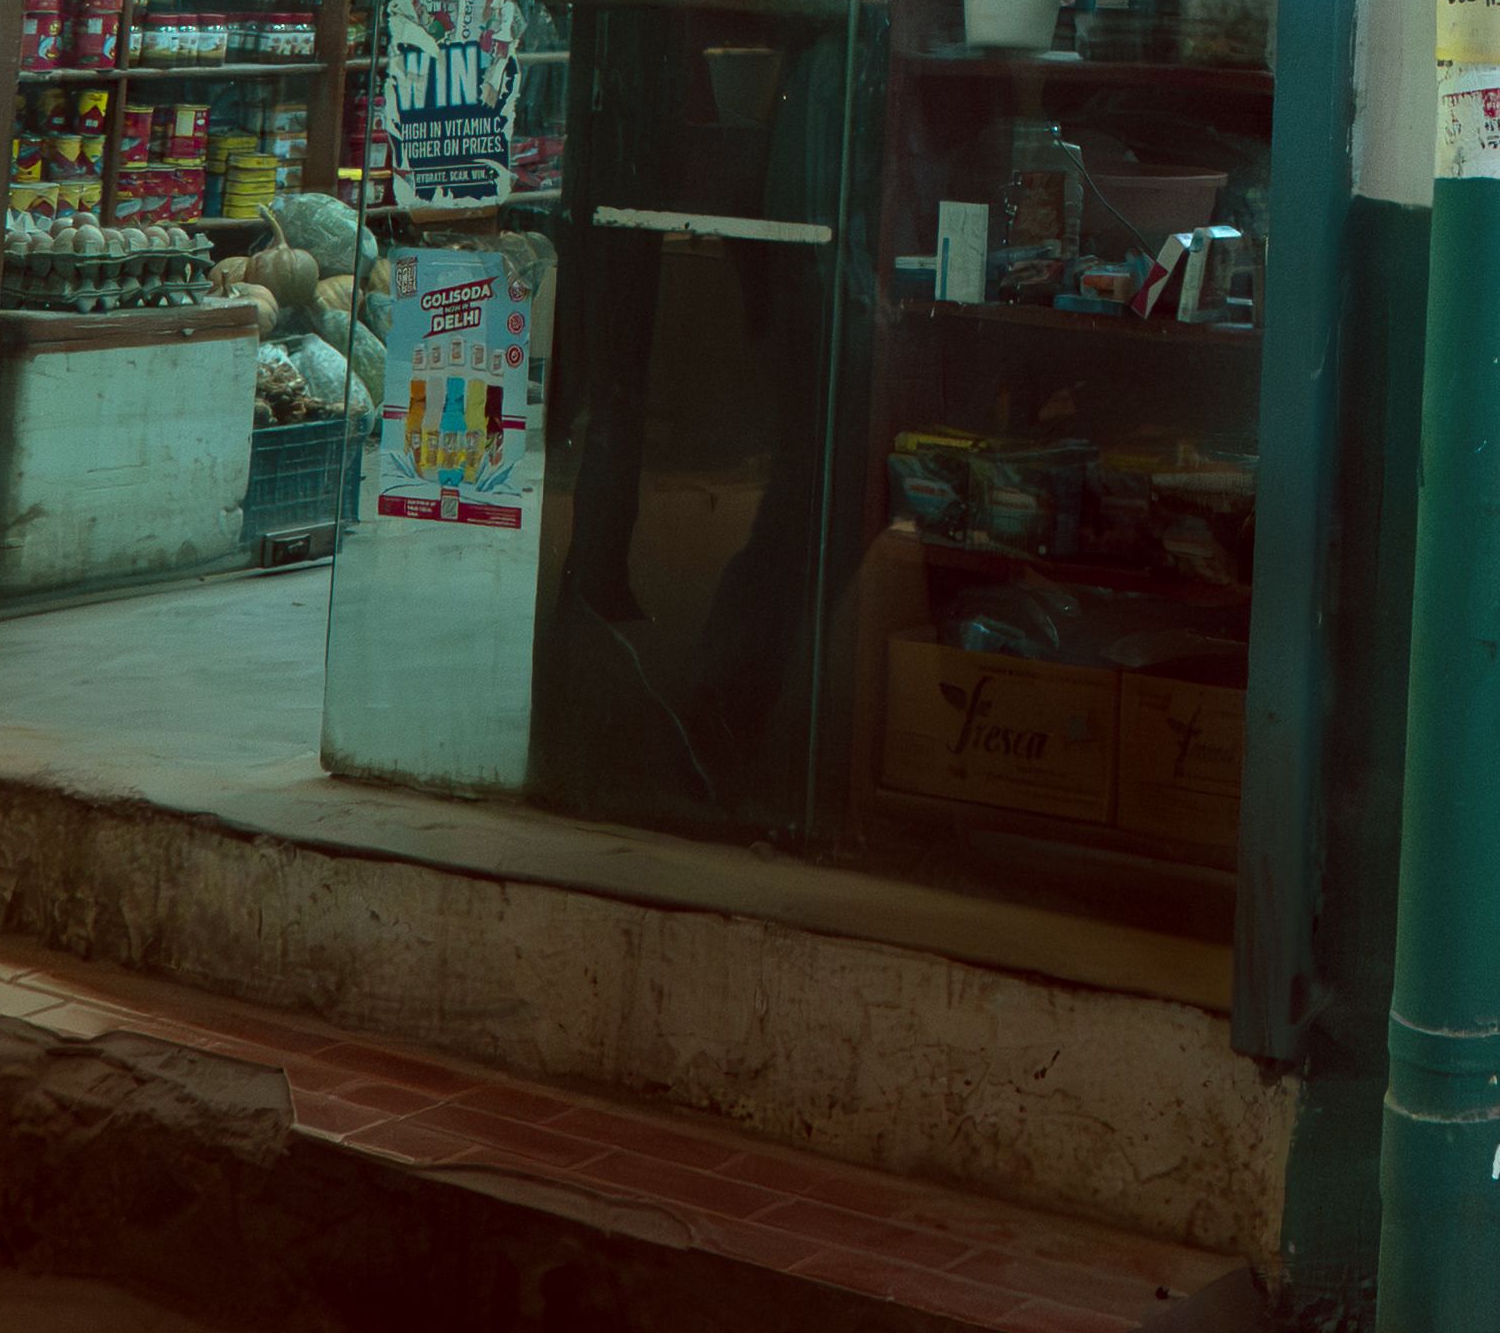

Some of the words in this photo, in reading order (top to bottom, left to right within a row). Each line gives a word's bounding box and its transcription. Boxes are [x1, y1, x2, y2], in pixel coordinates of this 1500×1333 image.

[397, 43, 479, 112] WIN
[401, 120, 428, 141] HIGH
[429, 119, 442, 139] IN
[443, 117, 492, 137] VITAMIN
[443, 137, 461, 157] ON
[421, 283, 492, 310] GOLISODA
[432, 309, 481, 332] DELHI
